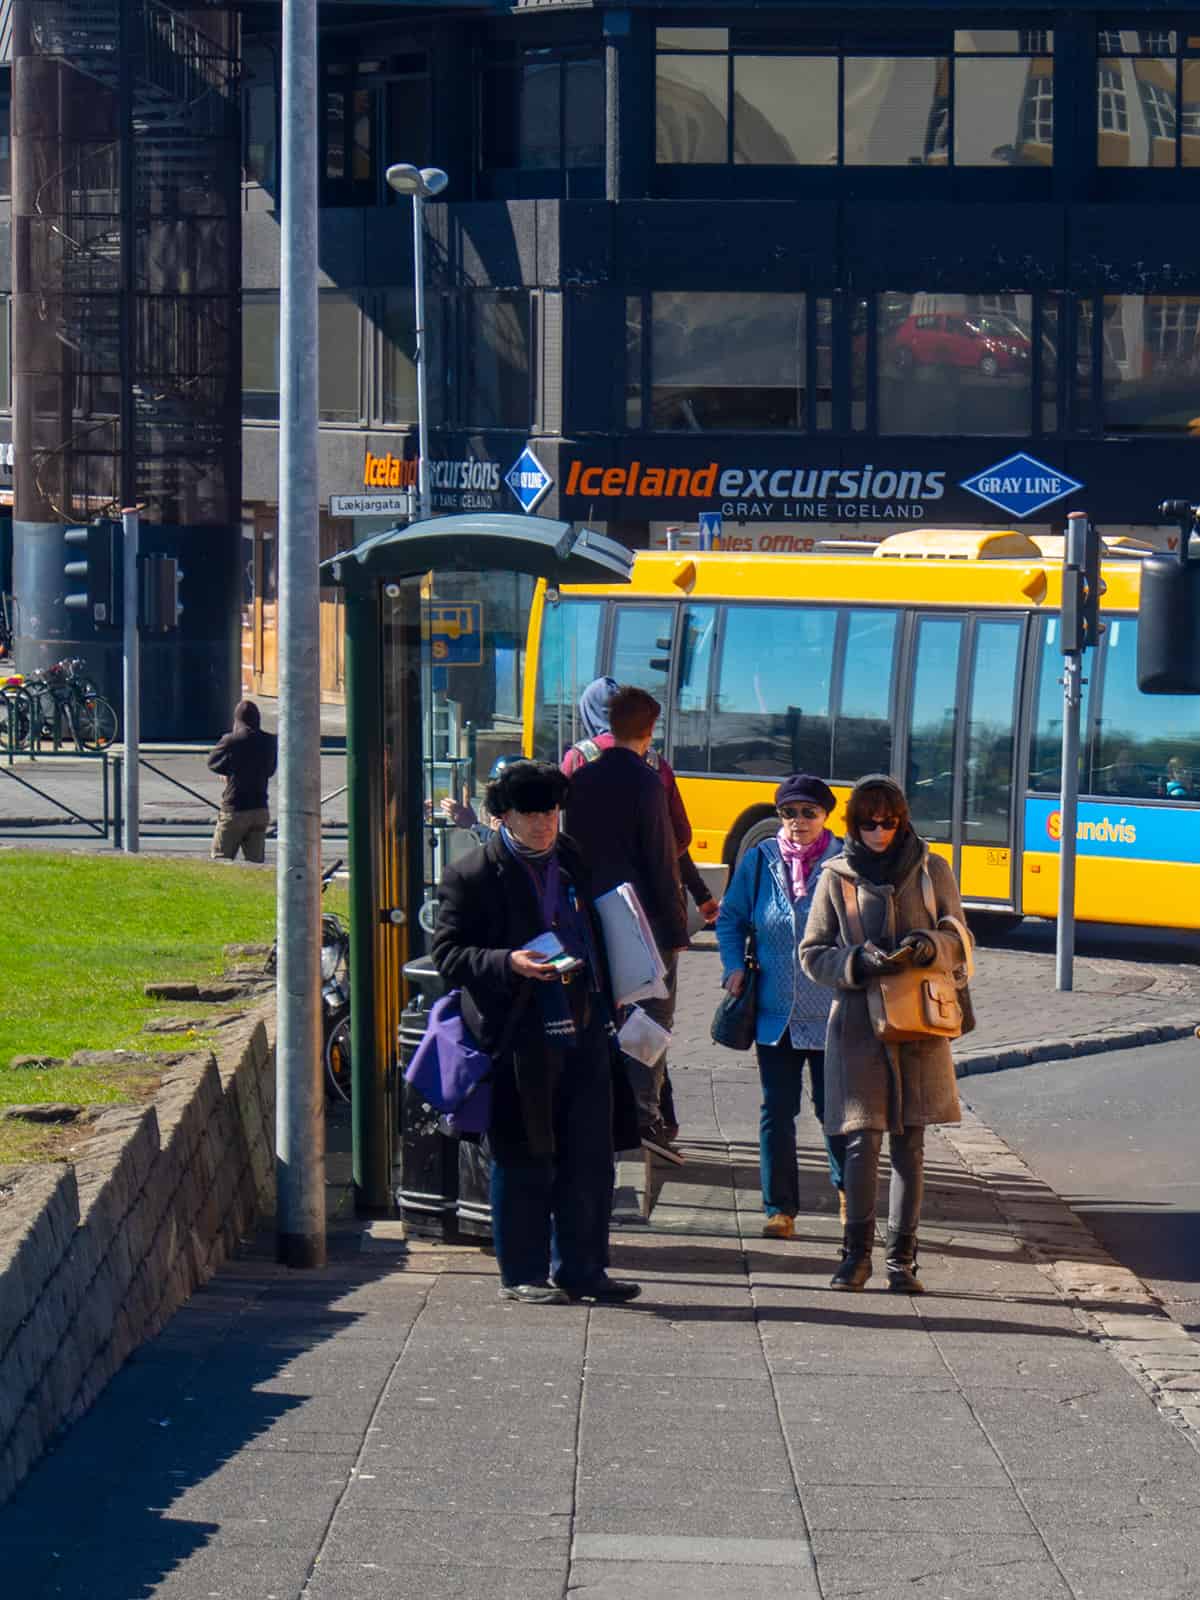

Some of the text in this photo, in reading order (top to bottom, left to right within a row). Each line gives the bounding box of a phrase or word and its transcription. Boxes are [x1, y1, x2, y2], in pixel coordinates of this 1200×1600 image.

[978, 477, 1061, 494] GRAY LINE
[337, 500, 401, 511] Lækjargata
[722, 502, 925, 519] GRAY LINE ICELAND
